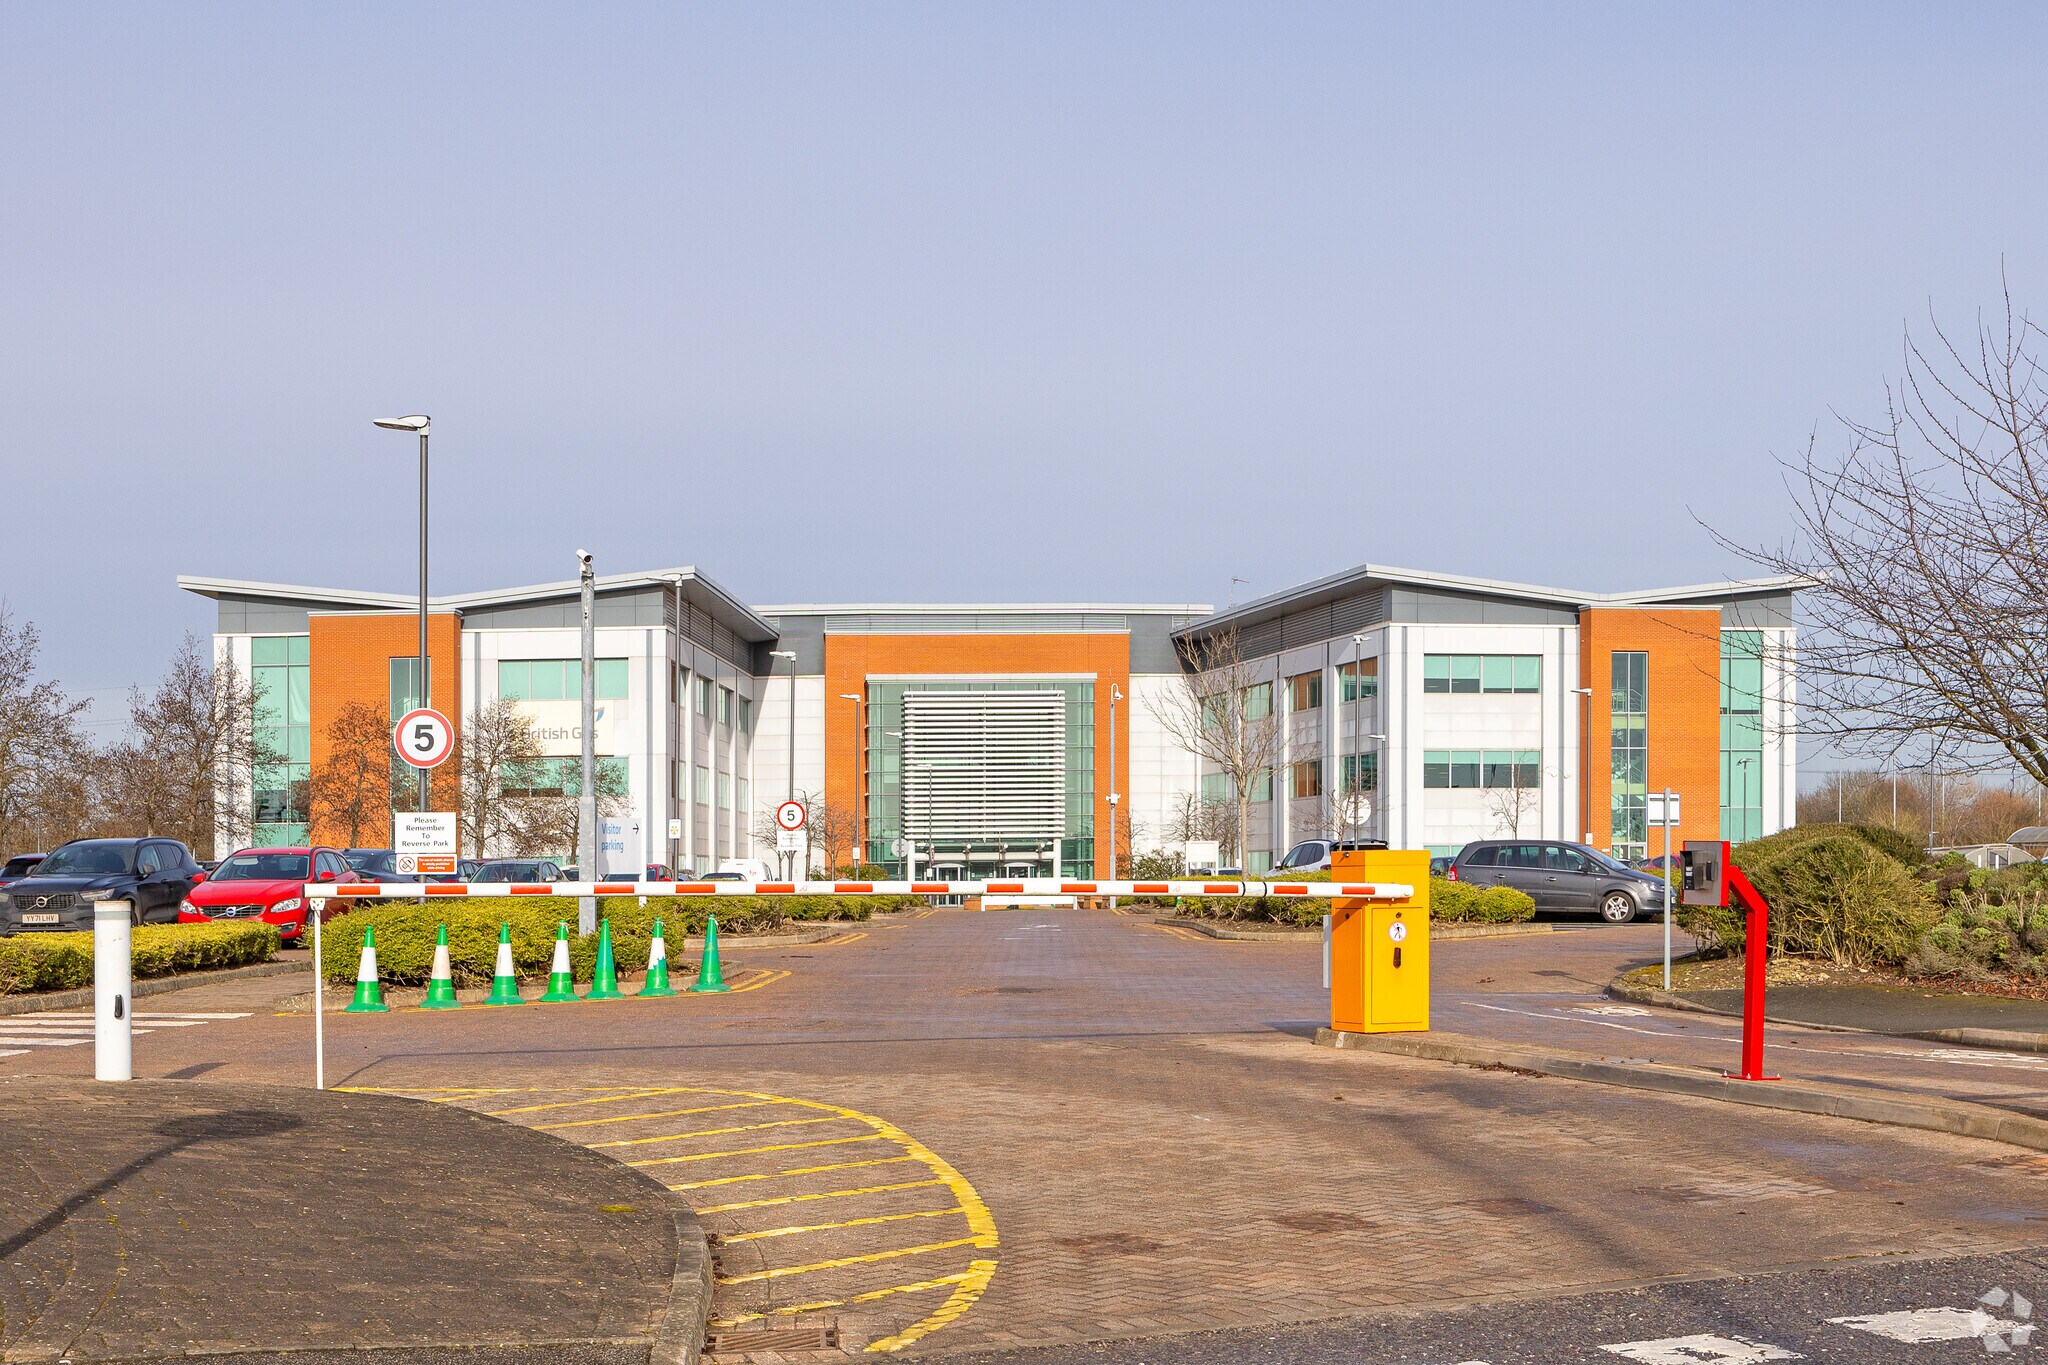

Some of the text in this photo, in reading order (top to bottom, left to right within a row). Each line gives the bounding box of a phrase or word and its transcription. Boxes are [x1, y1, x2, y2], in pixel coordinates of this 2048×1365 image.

[414, 724, 435, 752] 5
[522, 727, 599, 740] British Gs
[787, 810, 795, 821] 5
[601, 823, 622, 835] Visitor
[601, 839, 624, 853] parking
